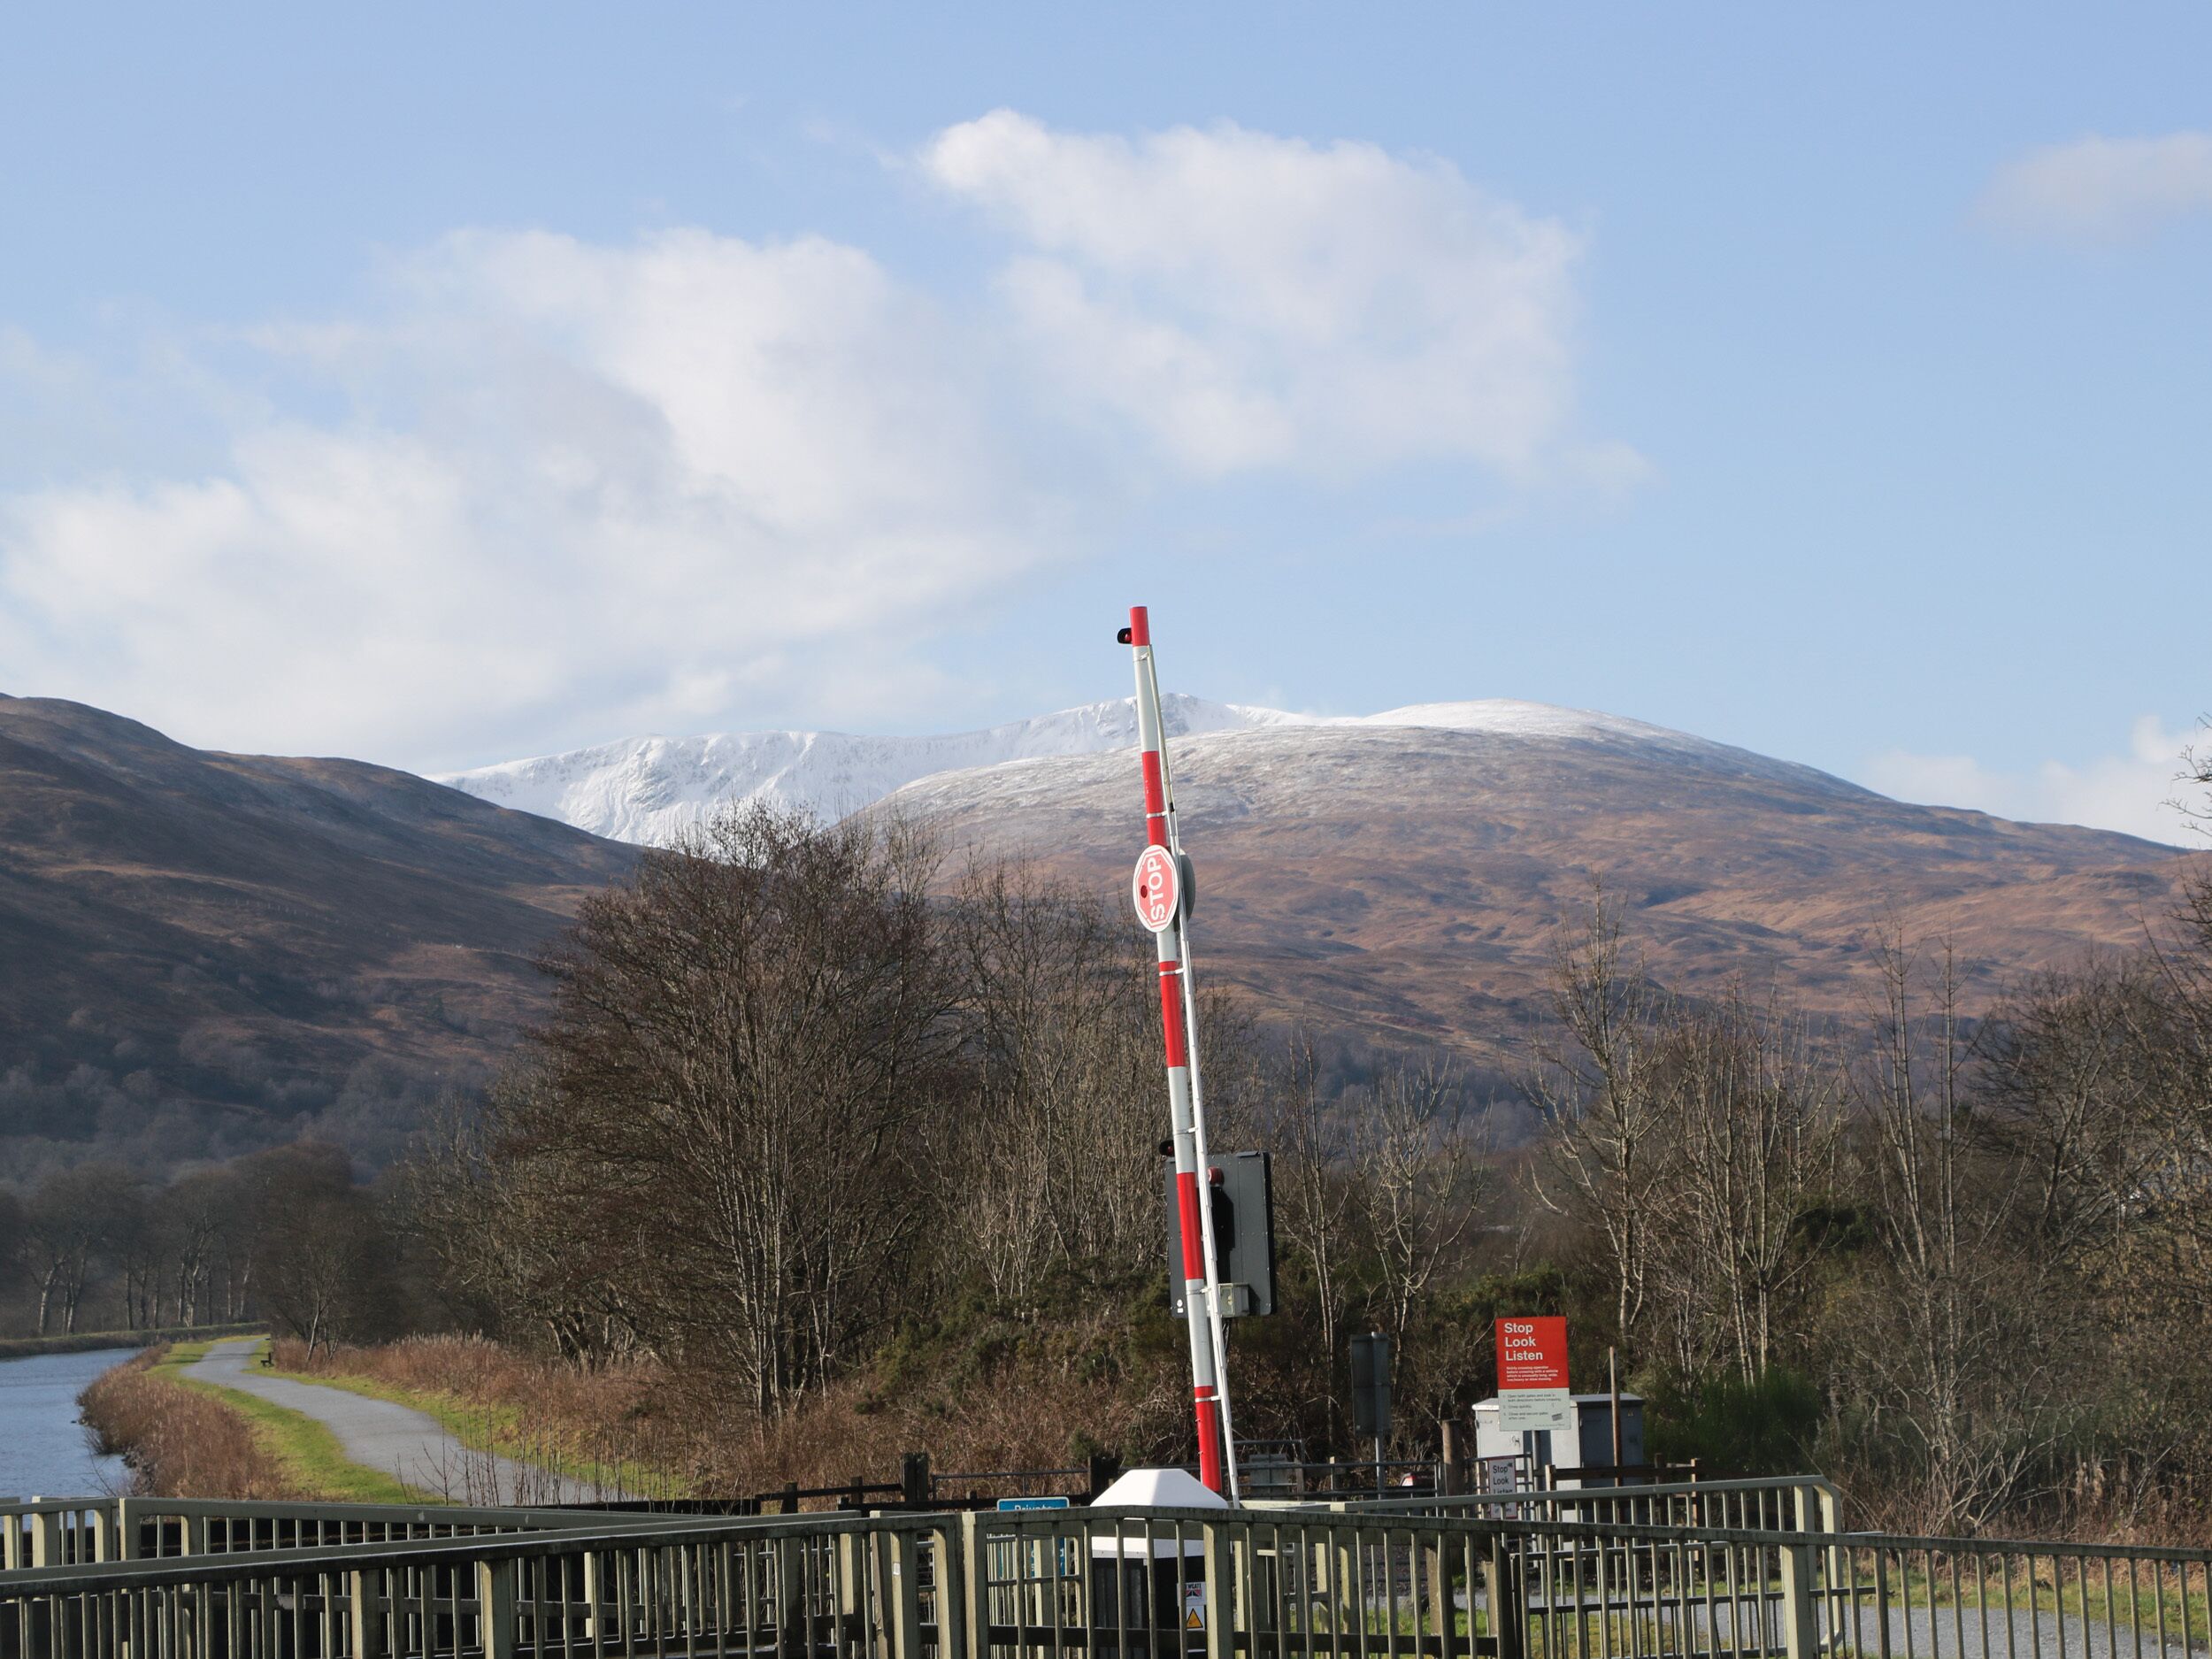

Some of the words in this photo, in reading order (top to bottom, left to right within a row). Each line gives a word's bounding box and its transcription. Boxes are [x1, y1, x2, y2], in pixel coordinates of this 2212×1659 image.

[1147, 856, 1165, 921] STOP
[1504, 1323, 1533, 1335] Stop
[1505, 1336, 1536, 1348] Look
[1506, 1350, 1543, 1362] Listen
[1493, 1465, 1508, 1474] Stop
[1493, 1476, 1509, 1485] Look
